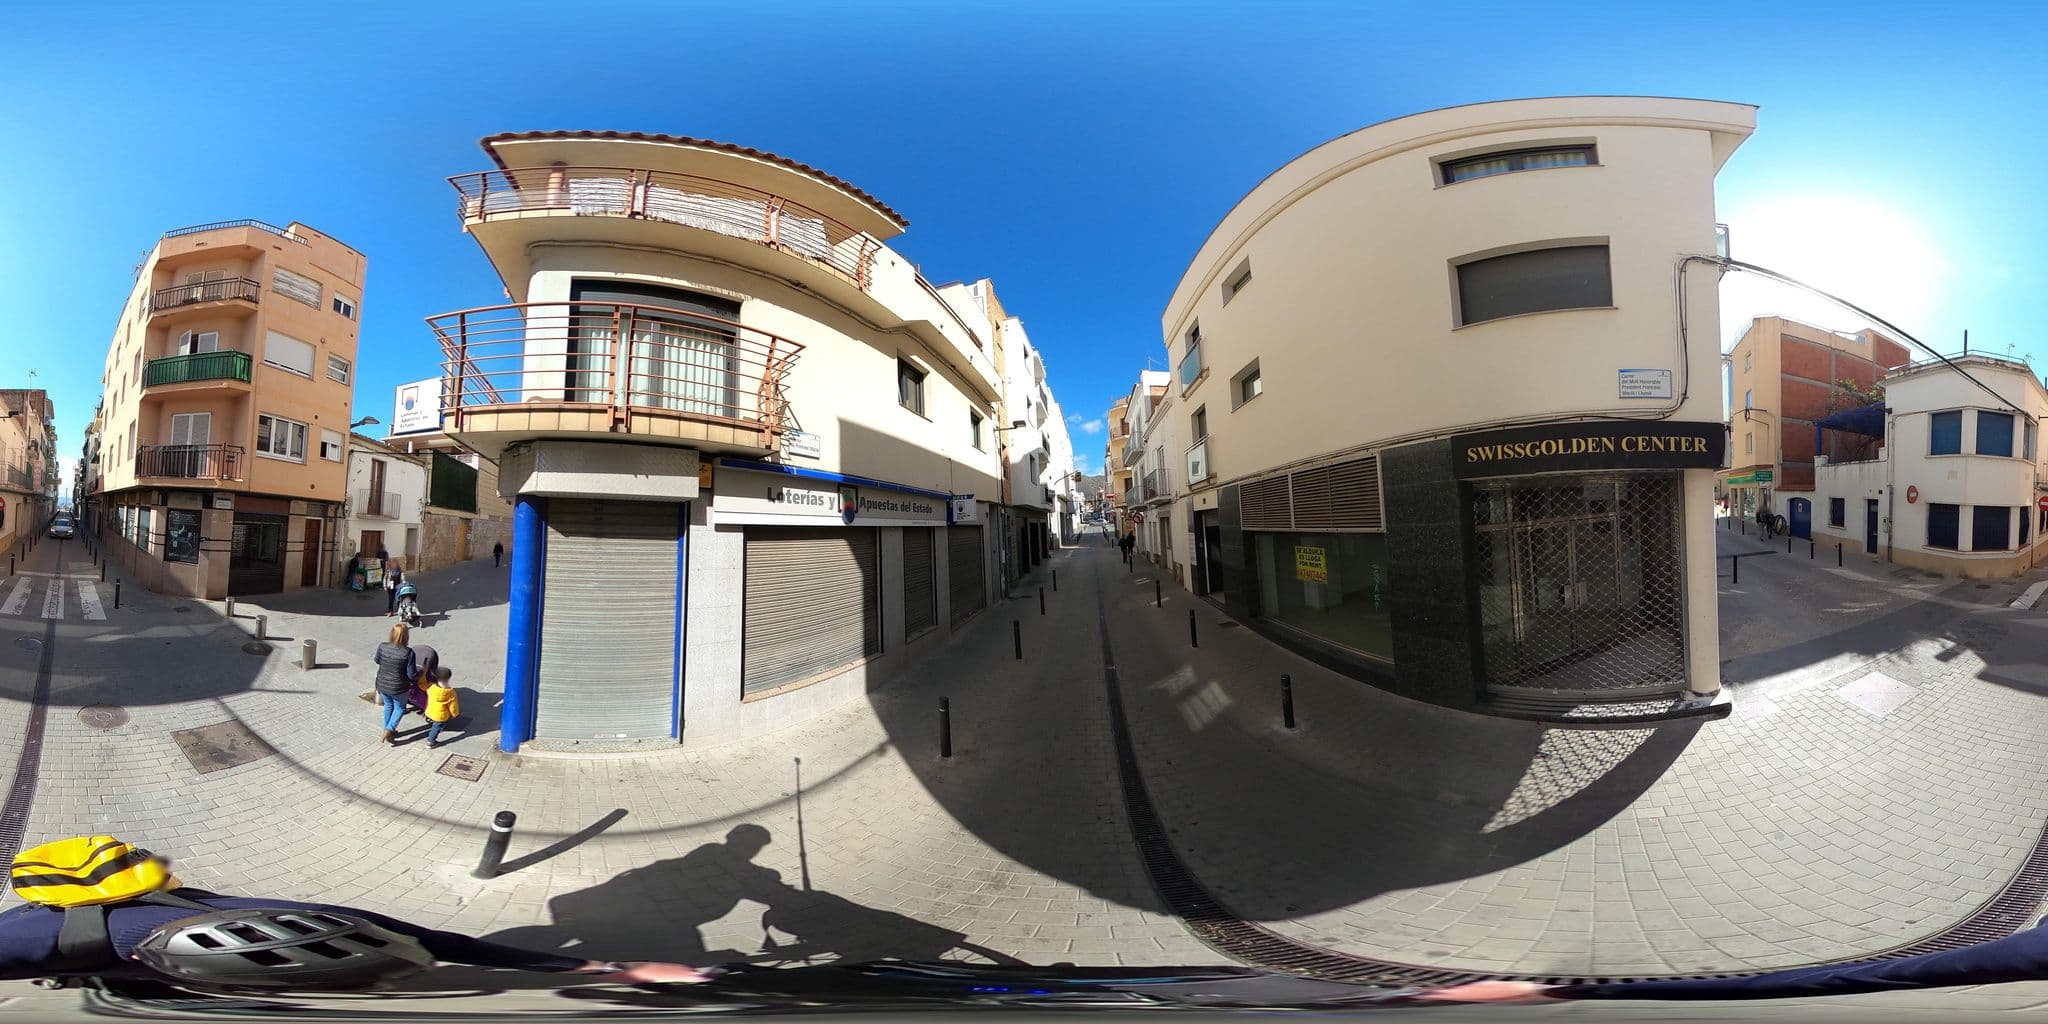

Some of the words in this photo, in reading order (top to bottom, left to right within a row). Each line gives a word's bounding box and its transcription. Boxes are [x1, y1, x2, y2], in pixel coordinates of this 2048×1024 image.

[1467, 436, 1615, 462] SWISSGOLDEN
[1621, 436, 1708, 453] CENTER
[767, 487, 824, 506] Loterías
[828, 495, 836, 510] y
[859, 496, 899, 512] Apuestas
[900, 501, 911, 512] del
[912, 502, 933, 514] Estado
